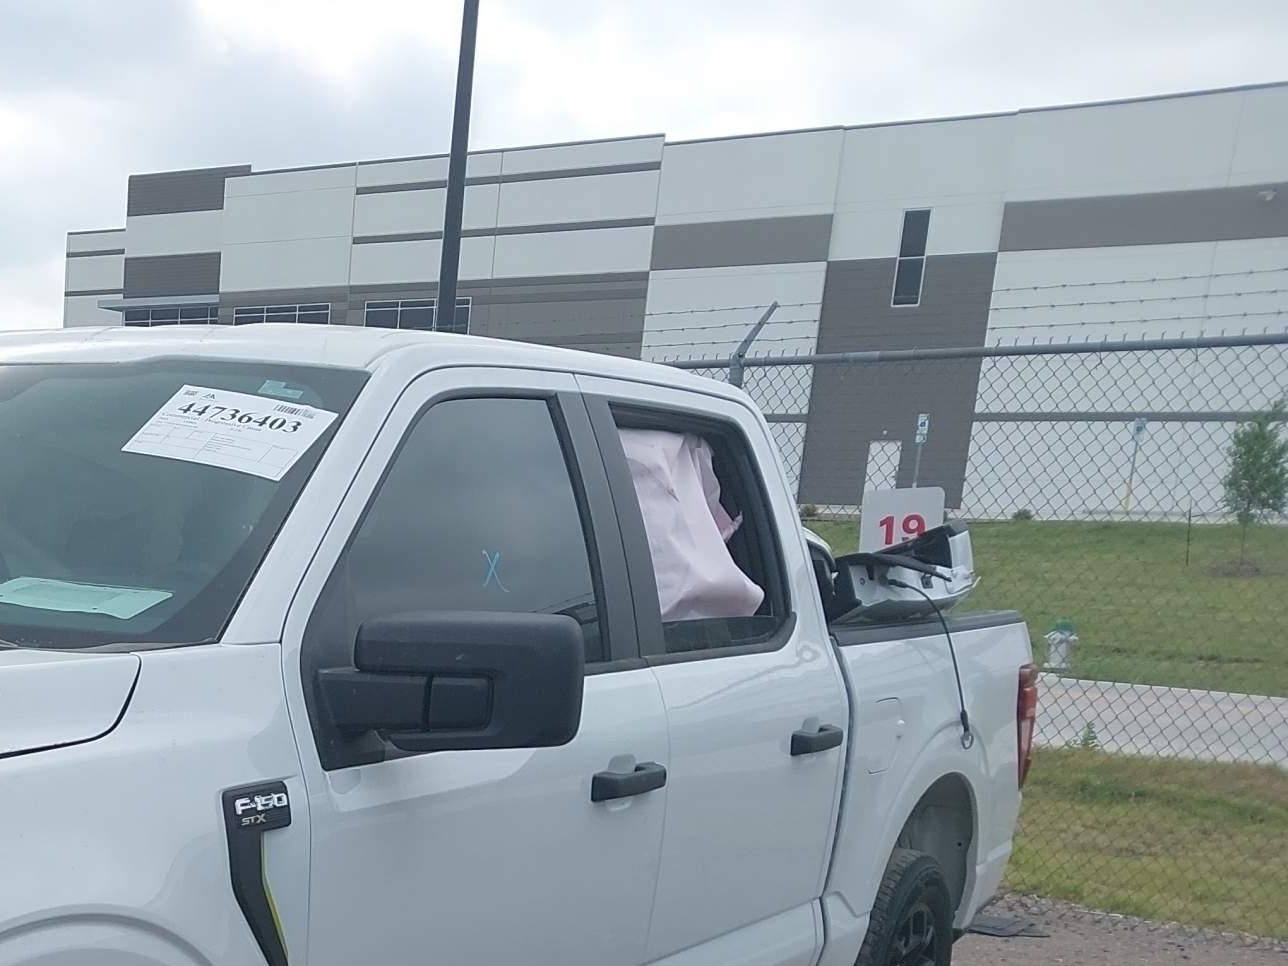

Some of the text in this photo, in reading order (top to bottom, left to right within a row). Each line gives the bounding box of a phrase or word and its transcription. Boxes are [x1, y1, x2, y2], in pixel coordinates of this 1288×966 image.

[177, 402, 303, 434] 44736403
[879, 514, 926, 546] 19
[234, 792, 288, 815] F-150
[241, 813, 267, 826] STX
